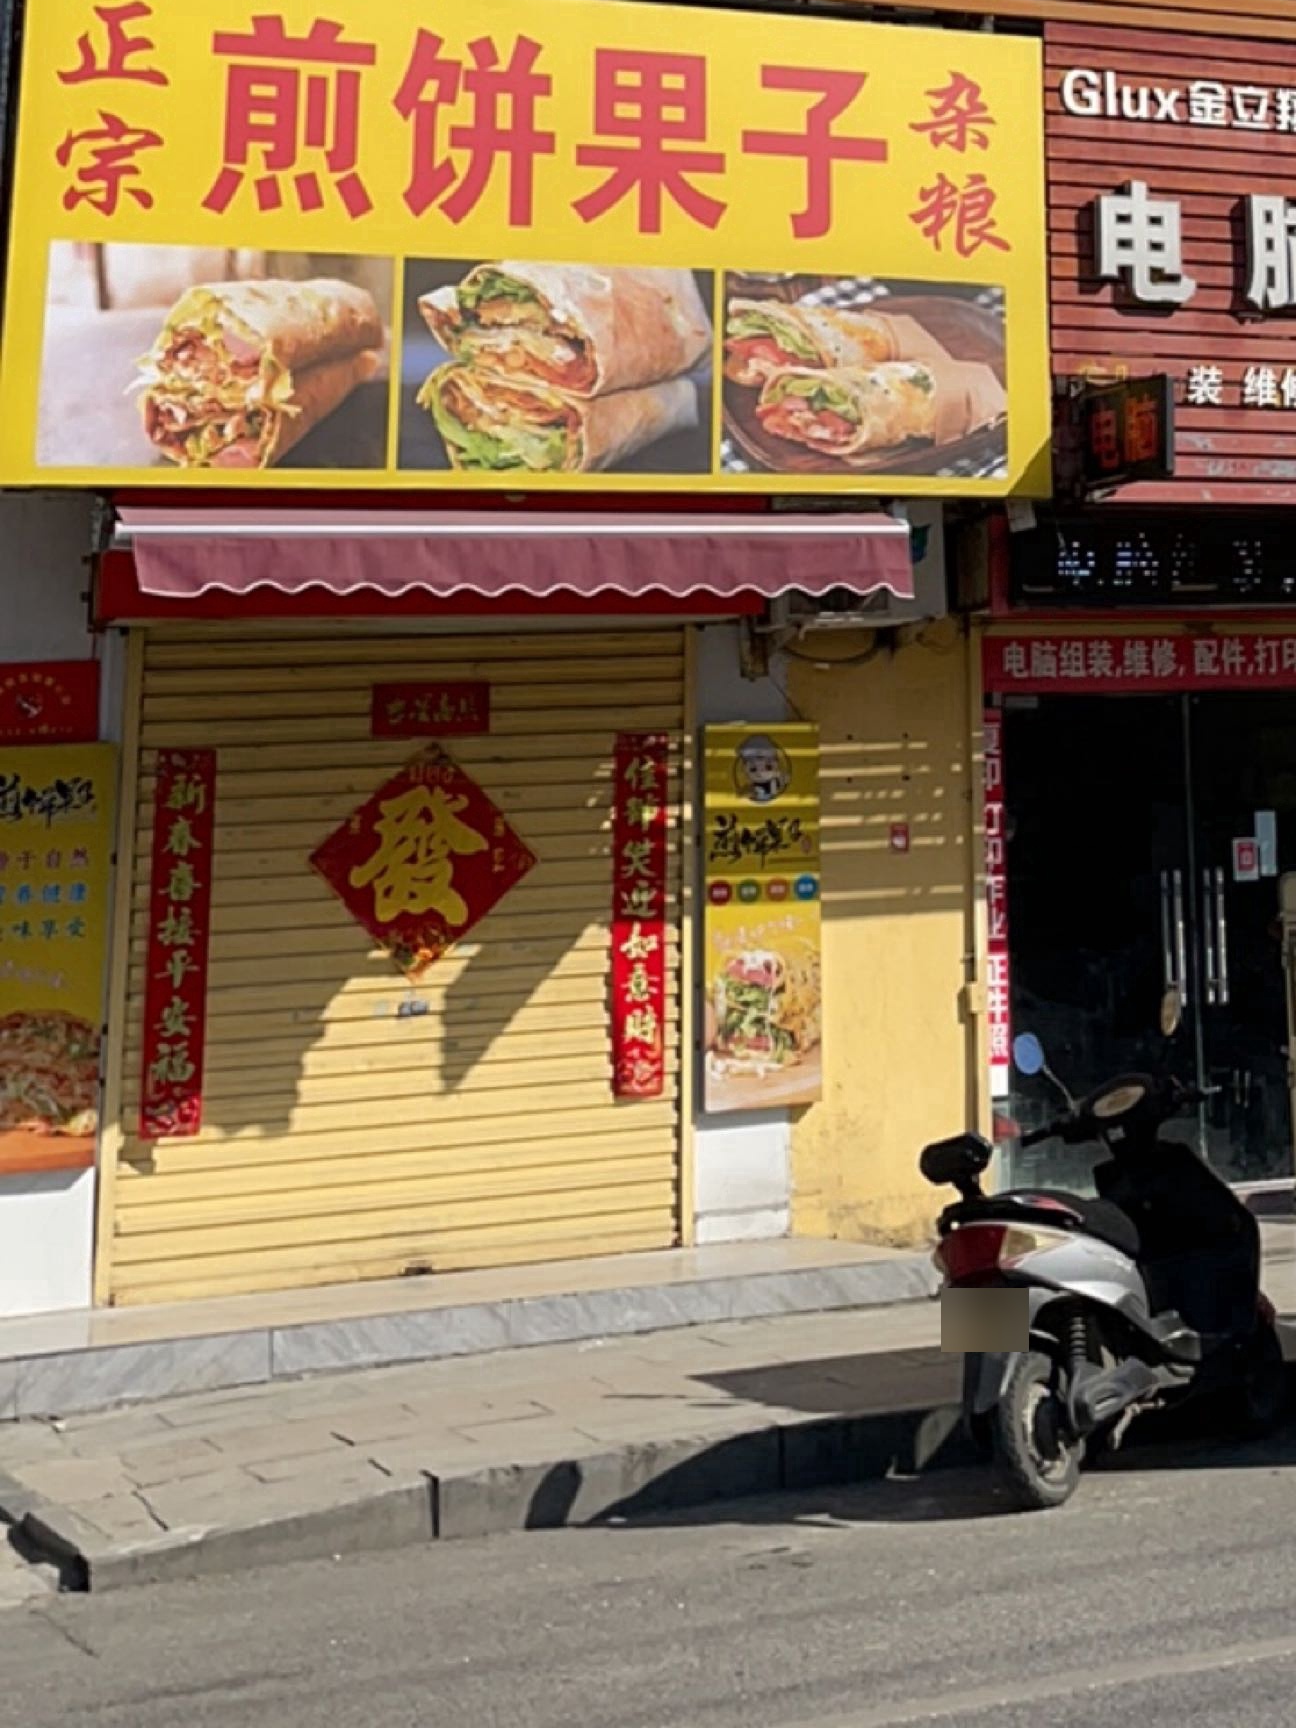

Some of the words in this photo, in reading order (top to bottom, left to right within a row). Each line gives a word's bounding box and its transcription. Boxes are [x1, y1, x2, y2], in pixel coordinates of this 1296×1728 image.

[56, 0, 169, 216] 正宗
[201, 14, 888, 239] 煎饼果子
[909, 71, 1011, 258] 杂粮
